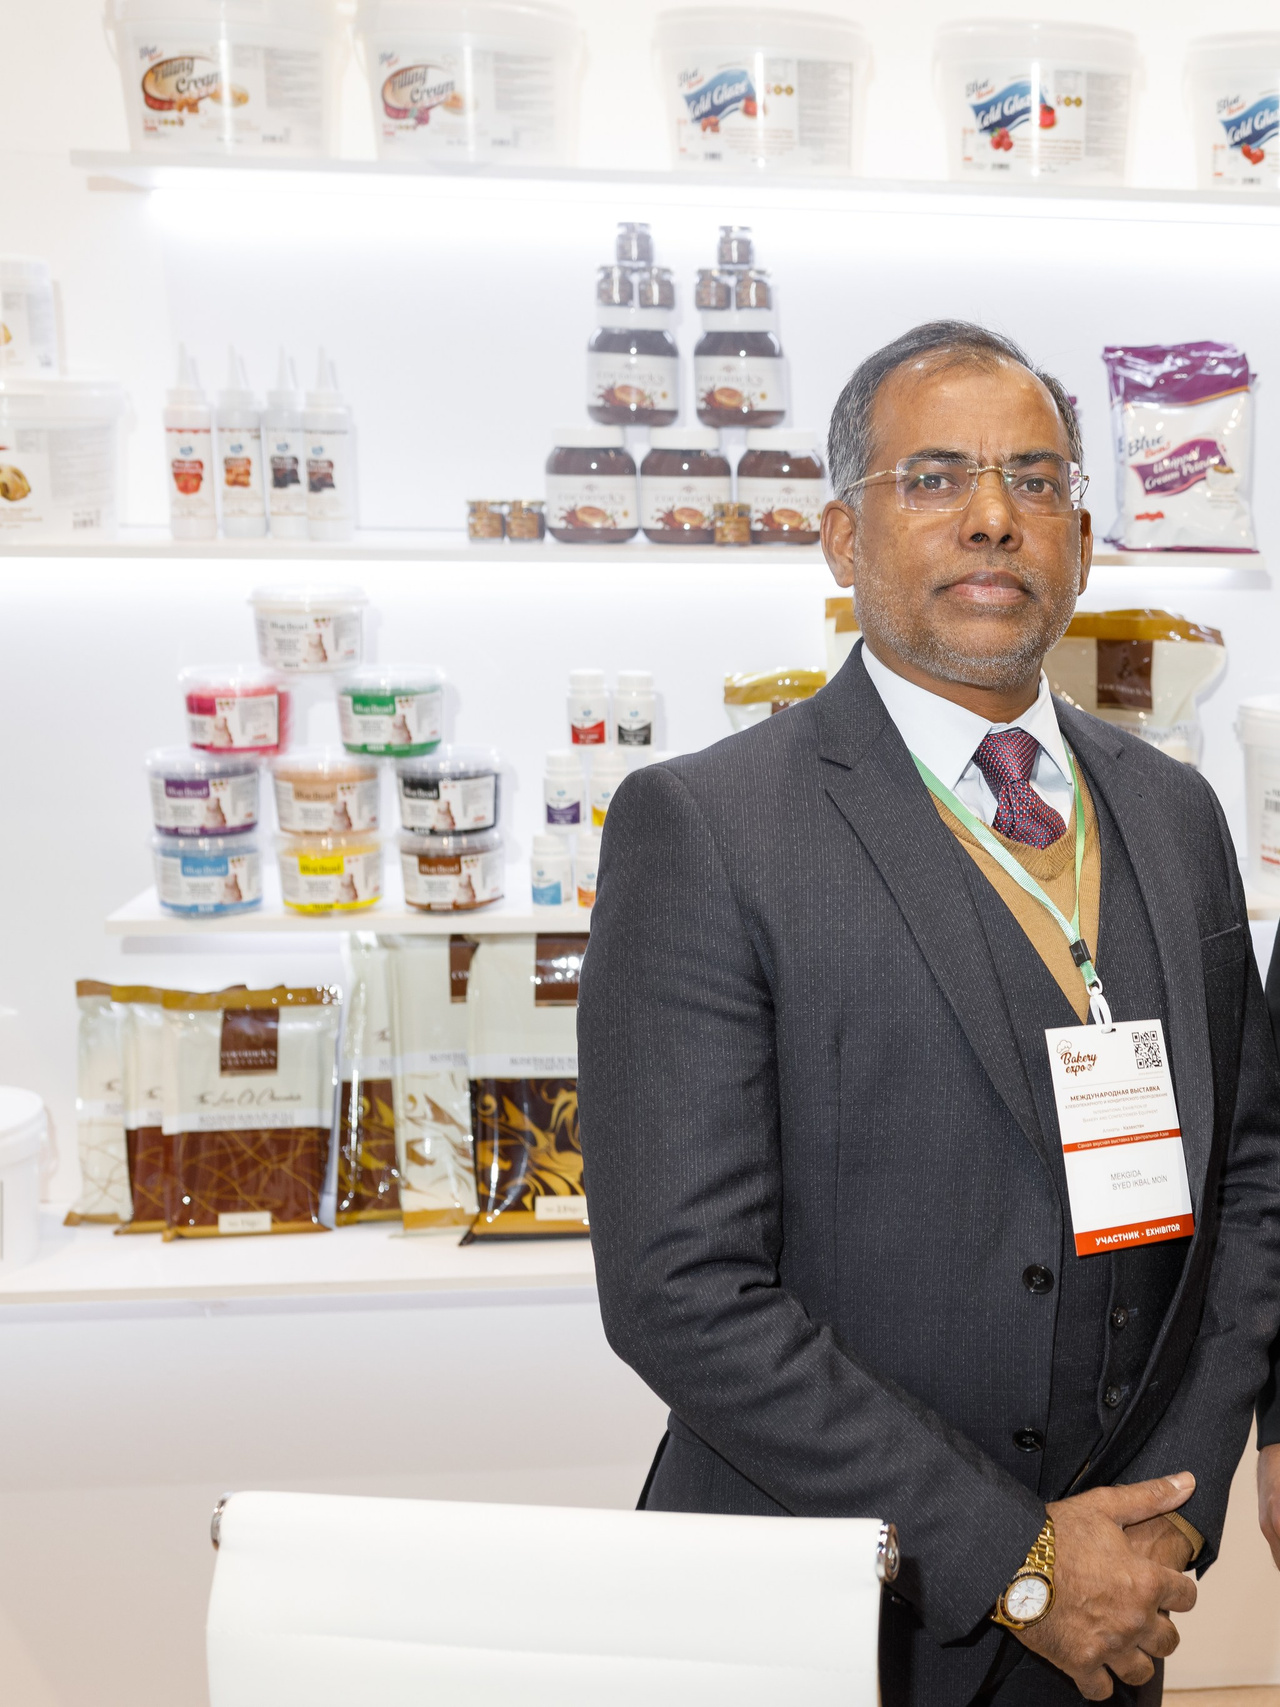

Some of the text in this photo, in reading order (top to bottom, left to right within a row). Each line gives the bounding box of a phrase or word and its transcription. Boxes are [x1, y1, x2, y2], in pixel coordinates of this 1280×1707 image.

[1060, 1051, 1098, 1067] Bakery
[1065, 1063, 1086, 1077] expo
[1070, 1085, 1161, 1102] МЕЖДУНАРОДНАЯ ВЫСТАВКА
[1110, 1169, 1142, 1181] MEKGIDA
[1112, 1180, 1132, 1191] SYED
[1095, 1231, 1140, 1246] УЧАСТНИК
[1145, 1223, 1181, 1237] EXHIBITOR
